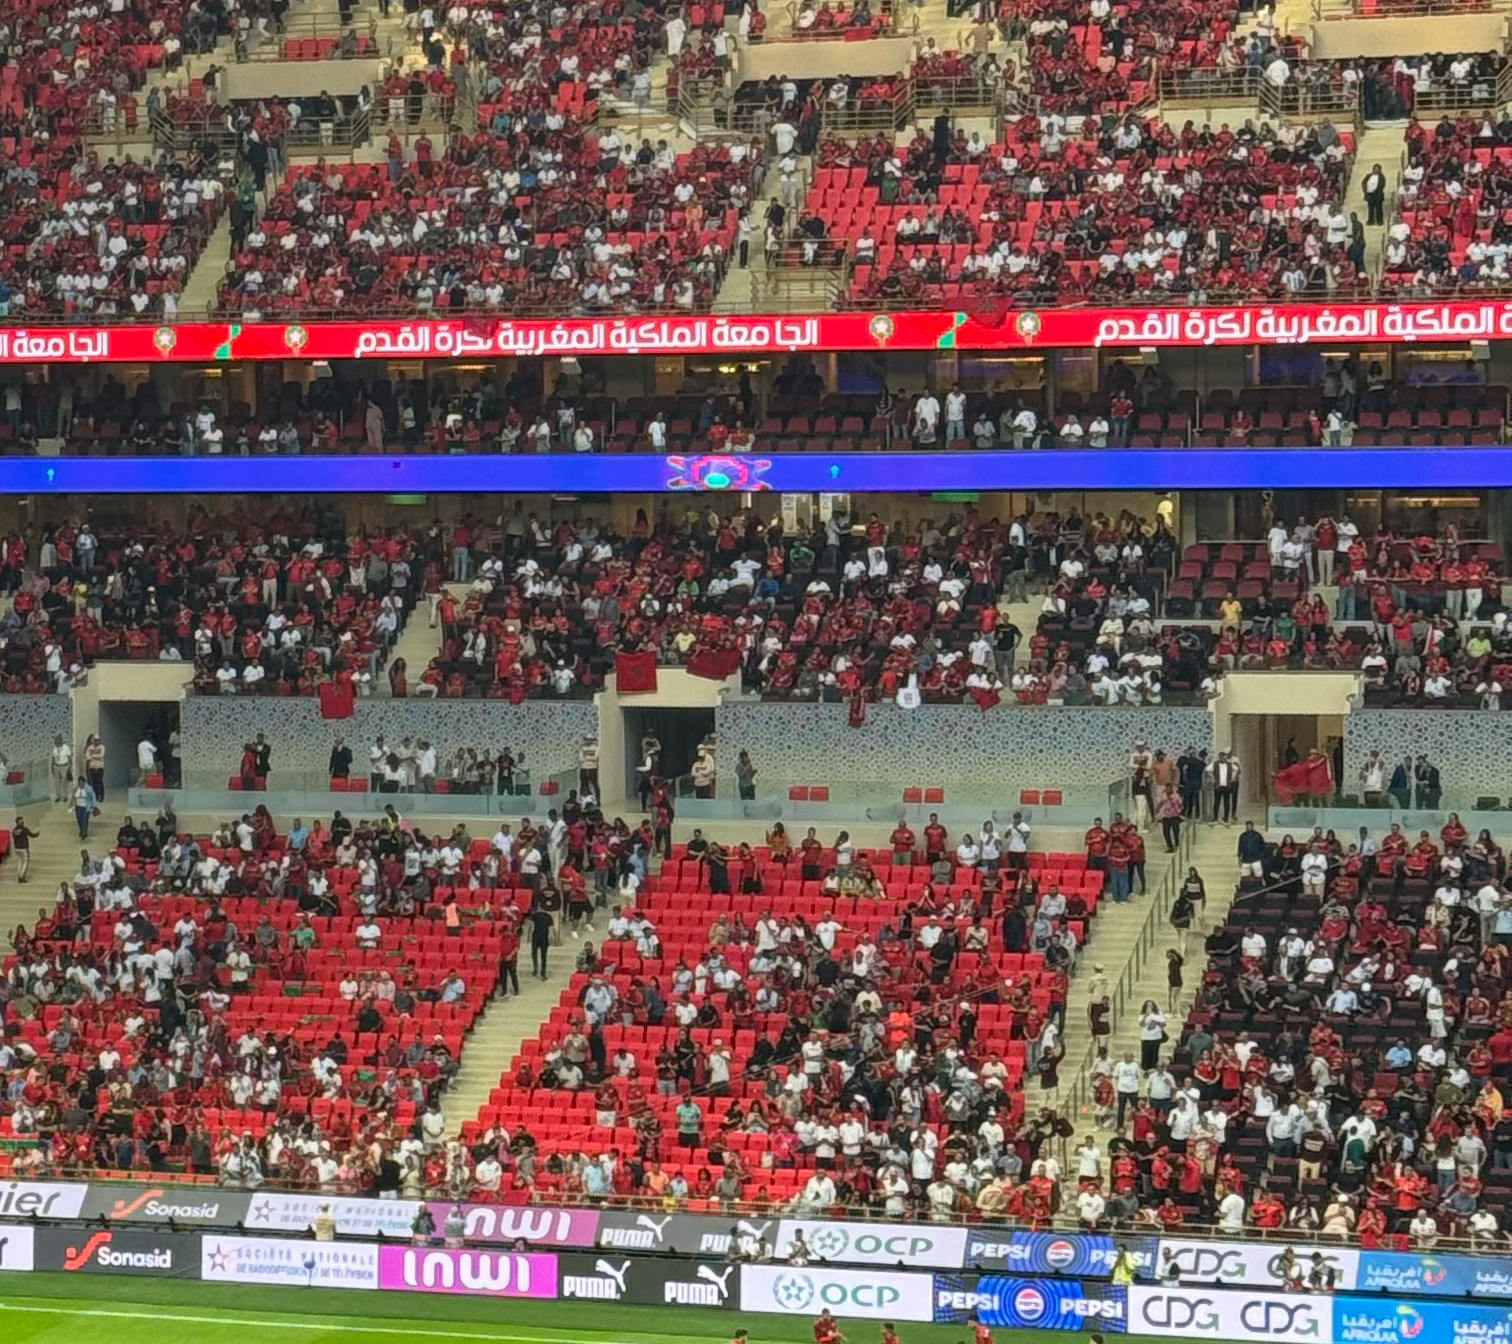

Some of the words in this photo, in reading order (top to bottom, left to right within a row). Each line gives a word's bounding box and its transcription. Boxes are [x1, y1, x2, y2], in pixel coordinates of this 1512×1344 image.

[497, 321, 606, 356] المغربية
[609, 320, 708, 355] الملكية
[1094, 312, 1180, 348] القدم
[1184, 311, 1251, 346] لكرة
[1255, 307, 1378, 344] المغربية
[1383, 304, 1495, 342] الملكية
[354, 325, 431, 359] القدم
[144, 1199, 220, 1219] Sonasid
[600, 1228, 655, 1248] PUMA
[854, 1234, 934, 1256] OCP
[970, 1242, 1032, 1260] PEPSI
[97, 1245, 172, 1269] Sonasid
[404, 1250, 530, 1292] inwi
[563, 1276, 617, 1299] PUMA
[664, 1281, 719, 1305] PUMA
[820, 1282, 900, 1307] OCP
[939, 1291, 1000, 1310] PEPSI
[1060, 1298, 1123, 1318] PEPSI
[1142, 1295, 1220, 1331] CDG
[1240, 1300, 1319, 1337] CDG
